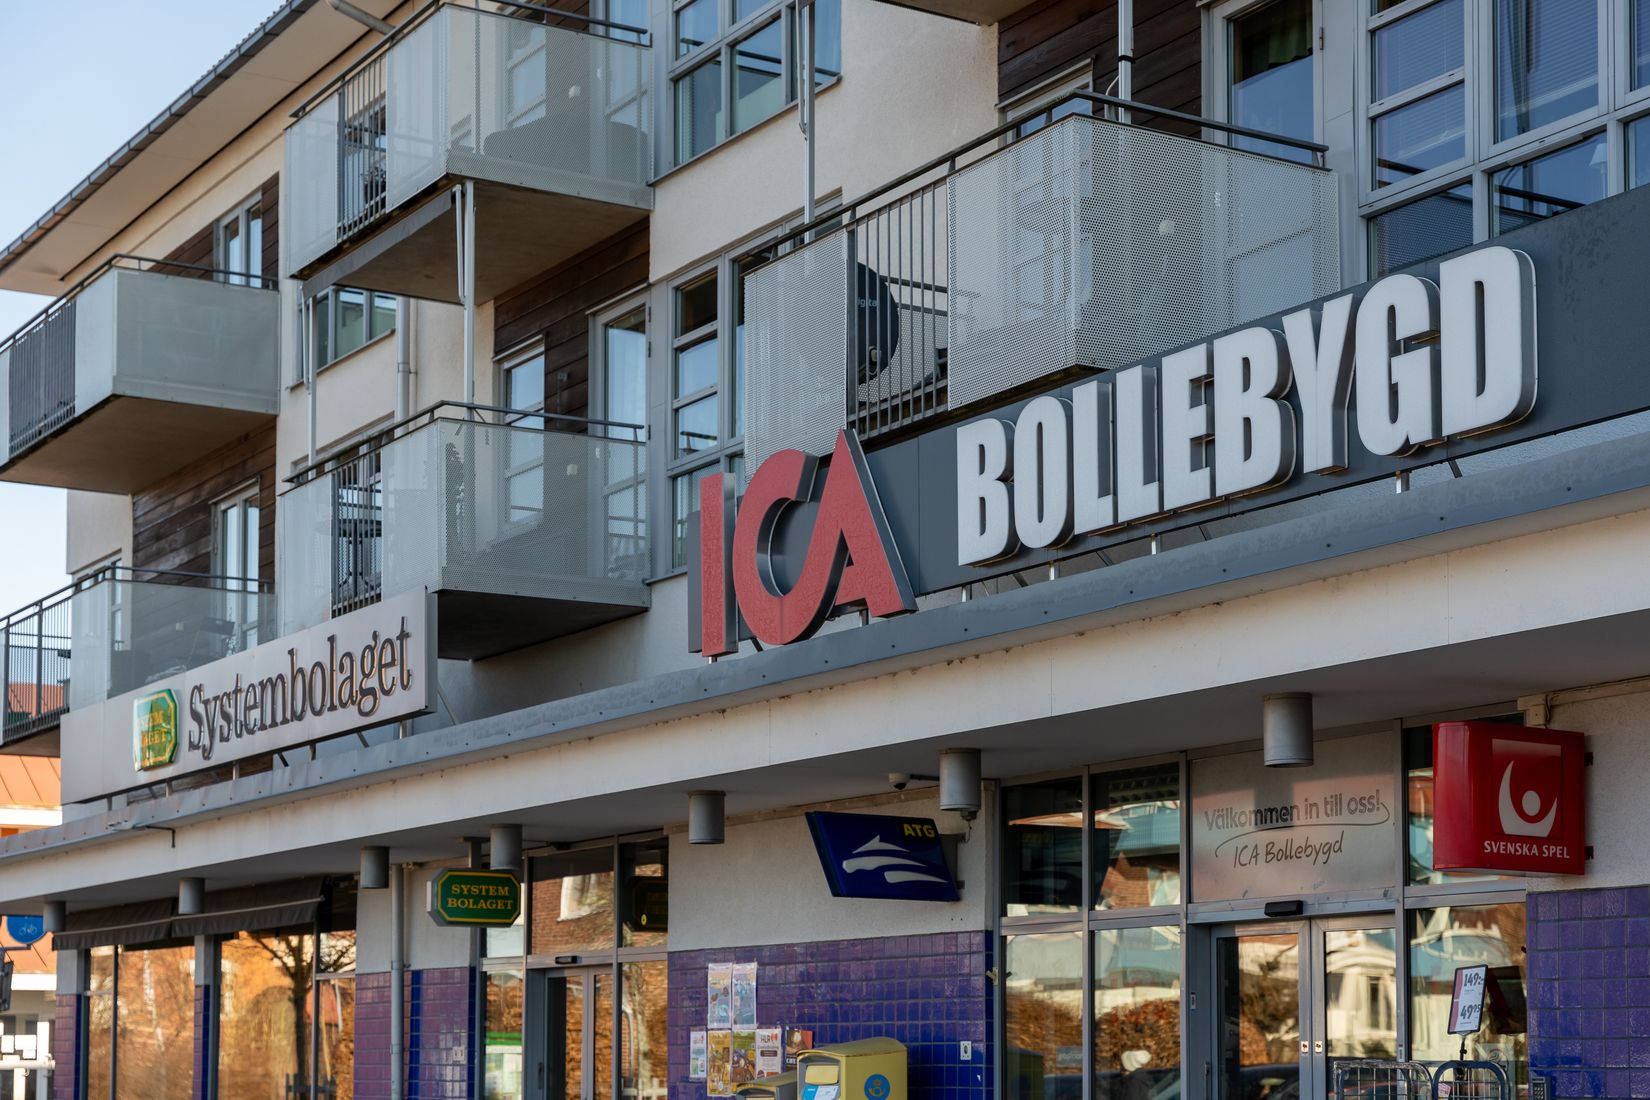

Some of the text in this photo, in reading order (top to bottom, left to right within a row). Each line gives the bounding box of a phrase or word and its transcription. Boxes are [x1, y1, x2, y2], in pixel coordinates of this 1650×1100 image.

[699, 245, 1537, 658] ICA BOLLEBYGD
[188, 616, 412, 761] Systembolaget
[1204, 789, 1381, 832] Välkommen in till oss!
[903, 823, 936, 838] ATG
[1233, 830, 1345, 868] ICA Bollebygd
[1483, 840, 1570, 859] SVENSKA SPEL
[447, 896, 513, 910] BOLAGET
[451, 884, 510, 897] SYSTEM
